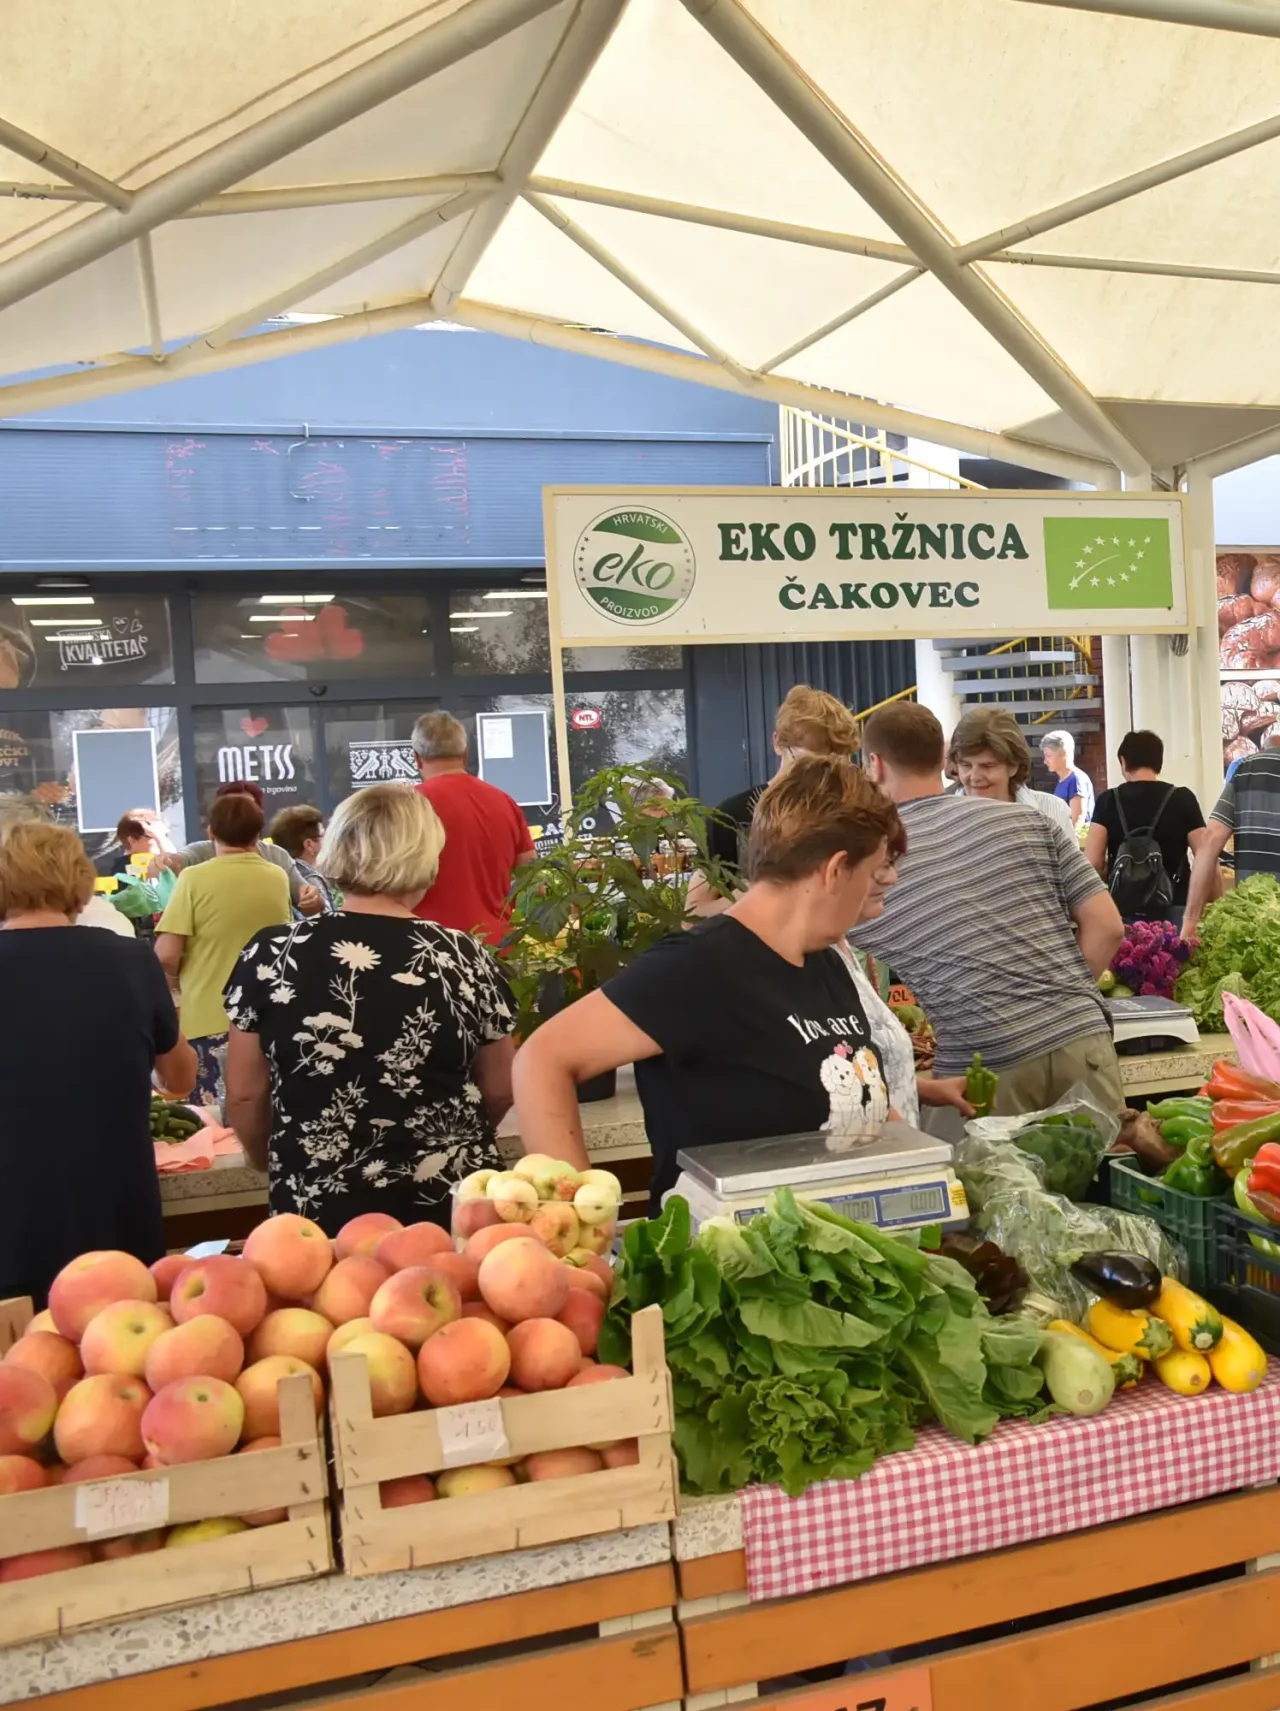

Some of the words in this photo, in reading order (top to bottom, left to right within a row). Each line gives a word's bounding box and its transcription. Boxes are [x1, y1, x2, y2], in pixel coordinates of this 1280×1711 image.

[613, 513, 669, 534] HRVATSKI
[717, 522, 817, 561] EKO
[829, 512, 1029, 560] TRŽNICA
[592, 543, 675, 590] eko
[778, 576, 980, 610] ČAKOVEC
[600, 596, 659, 618] PROIZVOD
[65, 639, 140, 662] KVALITETA
[578, 713, 595, 722] NTL
[786, 1013, 831, 1045] You
[827, 1014, 864, 1036] are
